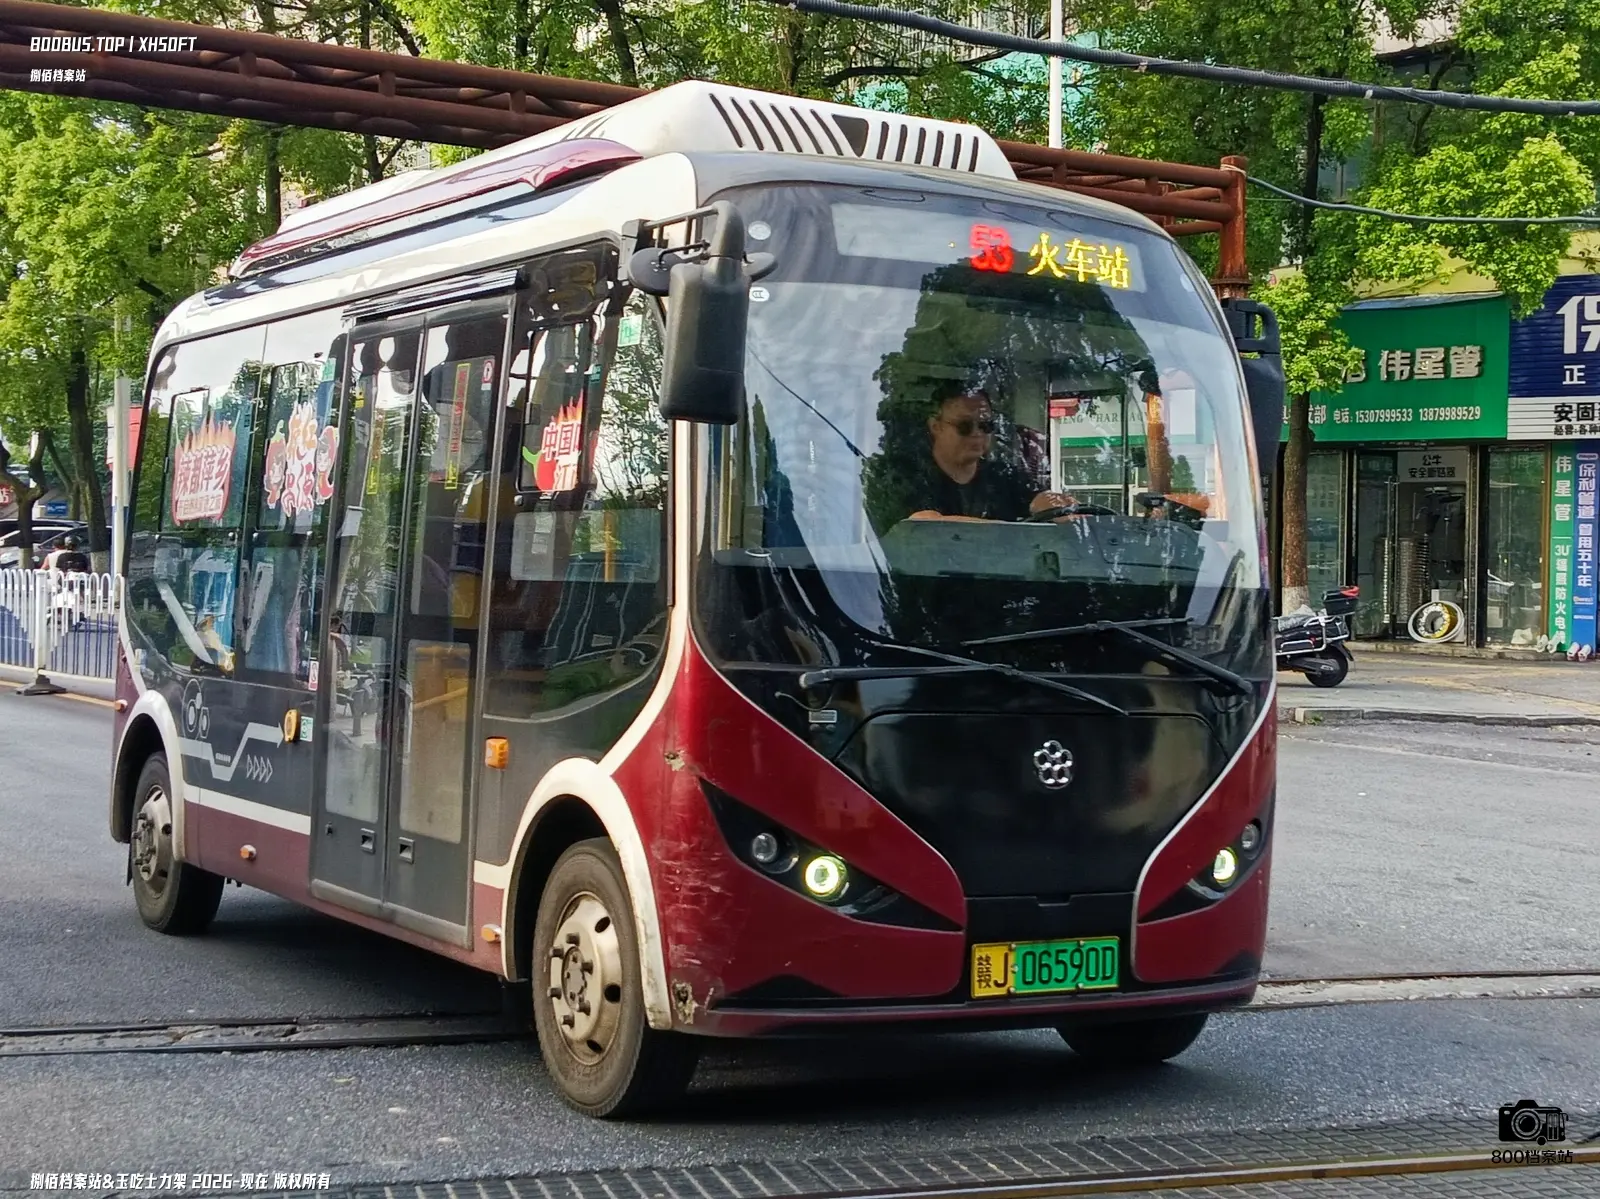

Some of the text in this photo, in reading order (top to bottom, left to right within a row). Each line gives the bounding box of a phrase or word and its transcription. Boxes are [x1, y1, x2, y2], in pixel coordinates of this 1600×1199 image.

[1027, 232, 1130, 289] 火车站
[1377, 344, 1483, 381] 伟星管
[1355, 408, 1413, 423] 15307999533
[1419, 405, 1481, 422] 13879989529
[1554, 402, 1600, 423] 安固
[1022, 946, 1116, 986] 06590D
